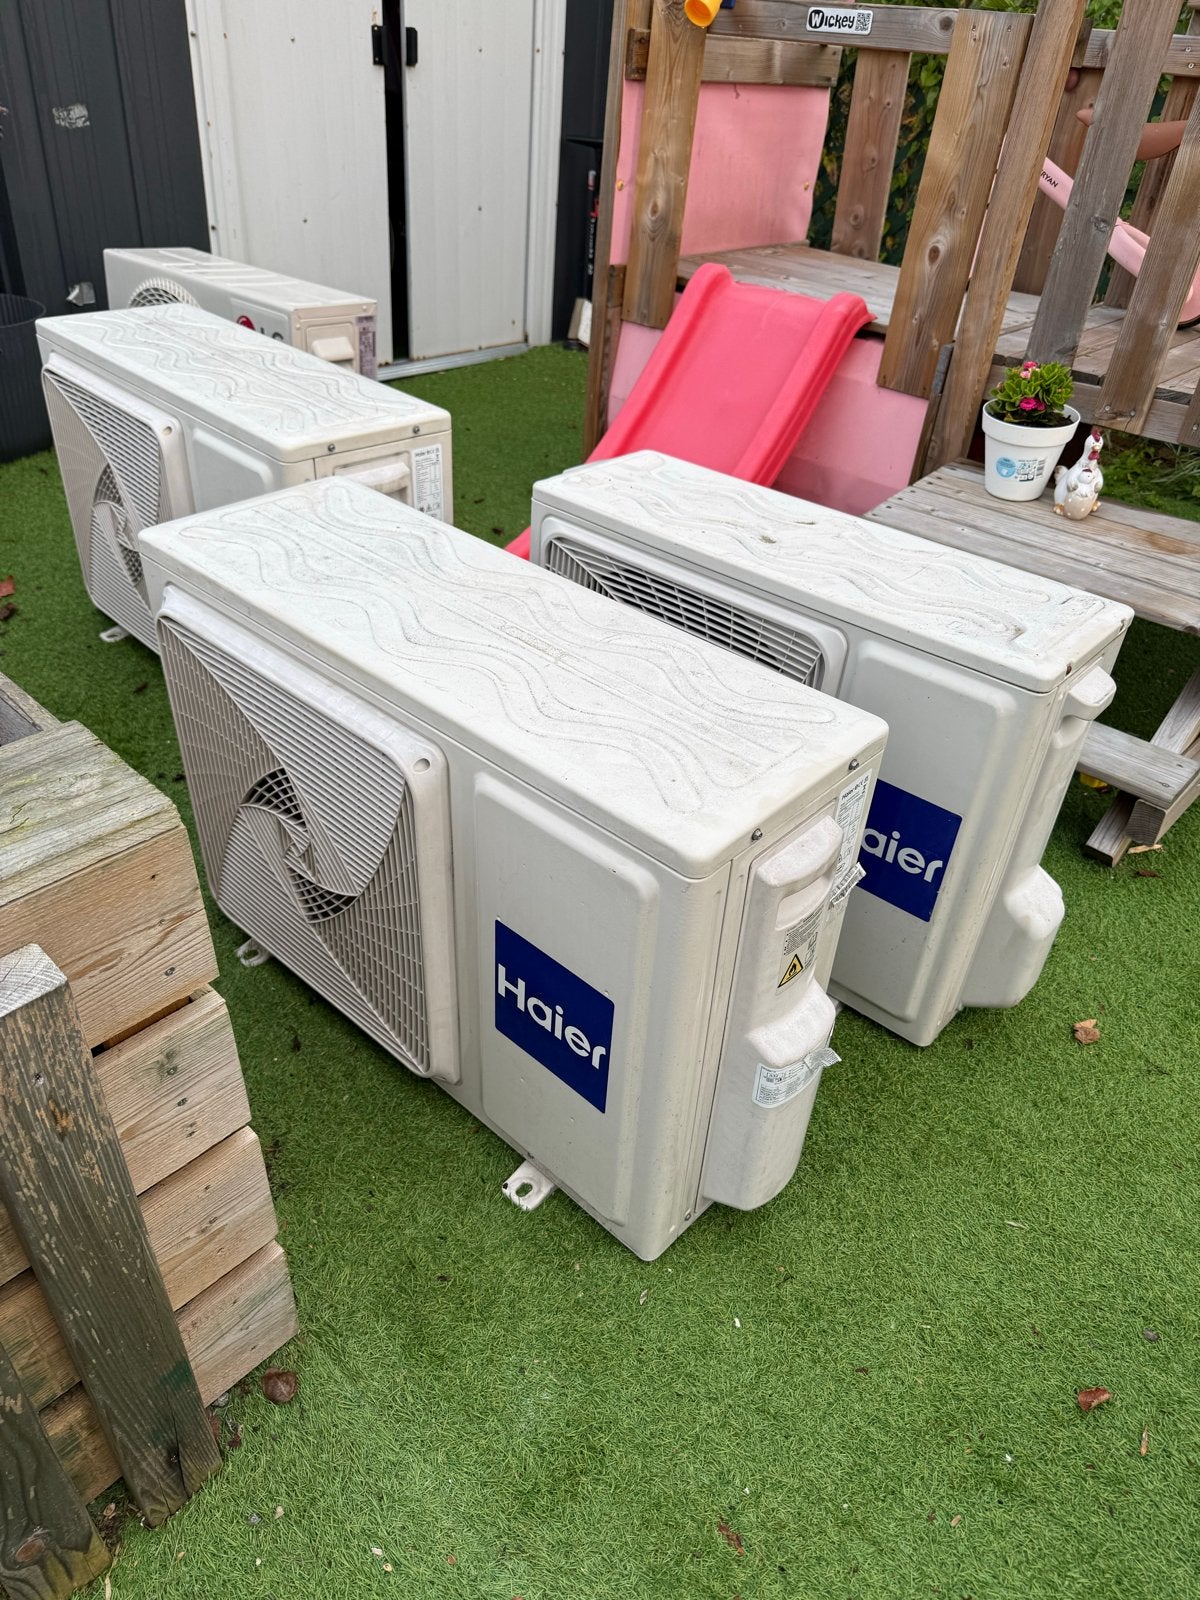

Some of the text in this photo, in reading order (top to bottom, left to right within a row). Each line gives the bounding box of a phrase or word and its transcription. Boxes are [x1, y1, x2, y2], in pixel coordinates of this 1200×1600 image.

[809, 9, 856, 29] Wickey
[1041, 169, 1059, 188] RYAN
[861, 828, 943, 883] aier
[498, 963, 606, 1070] Haier
